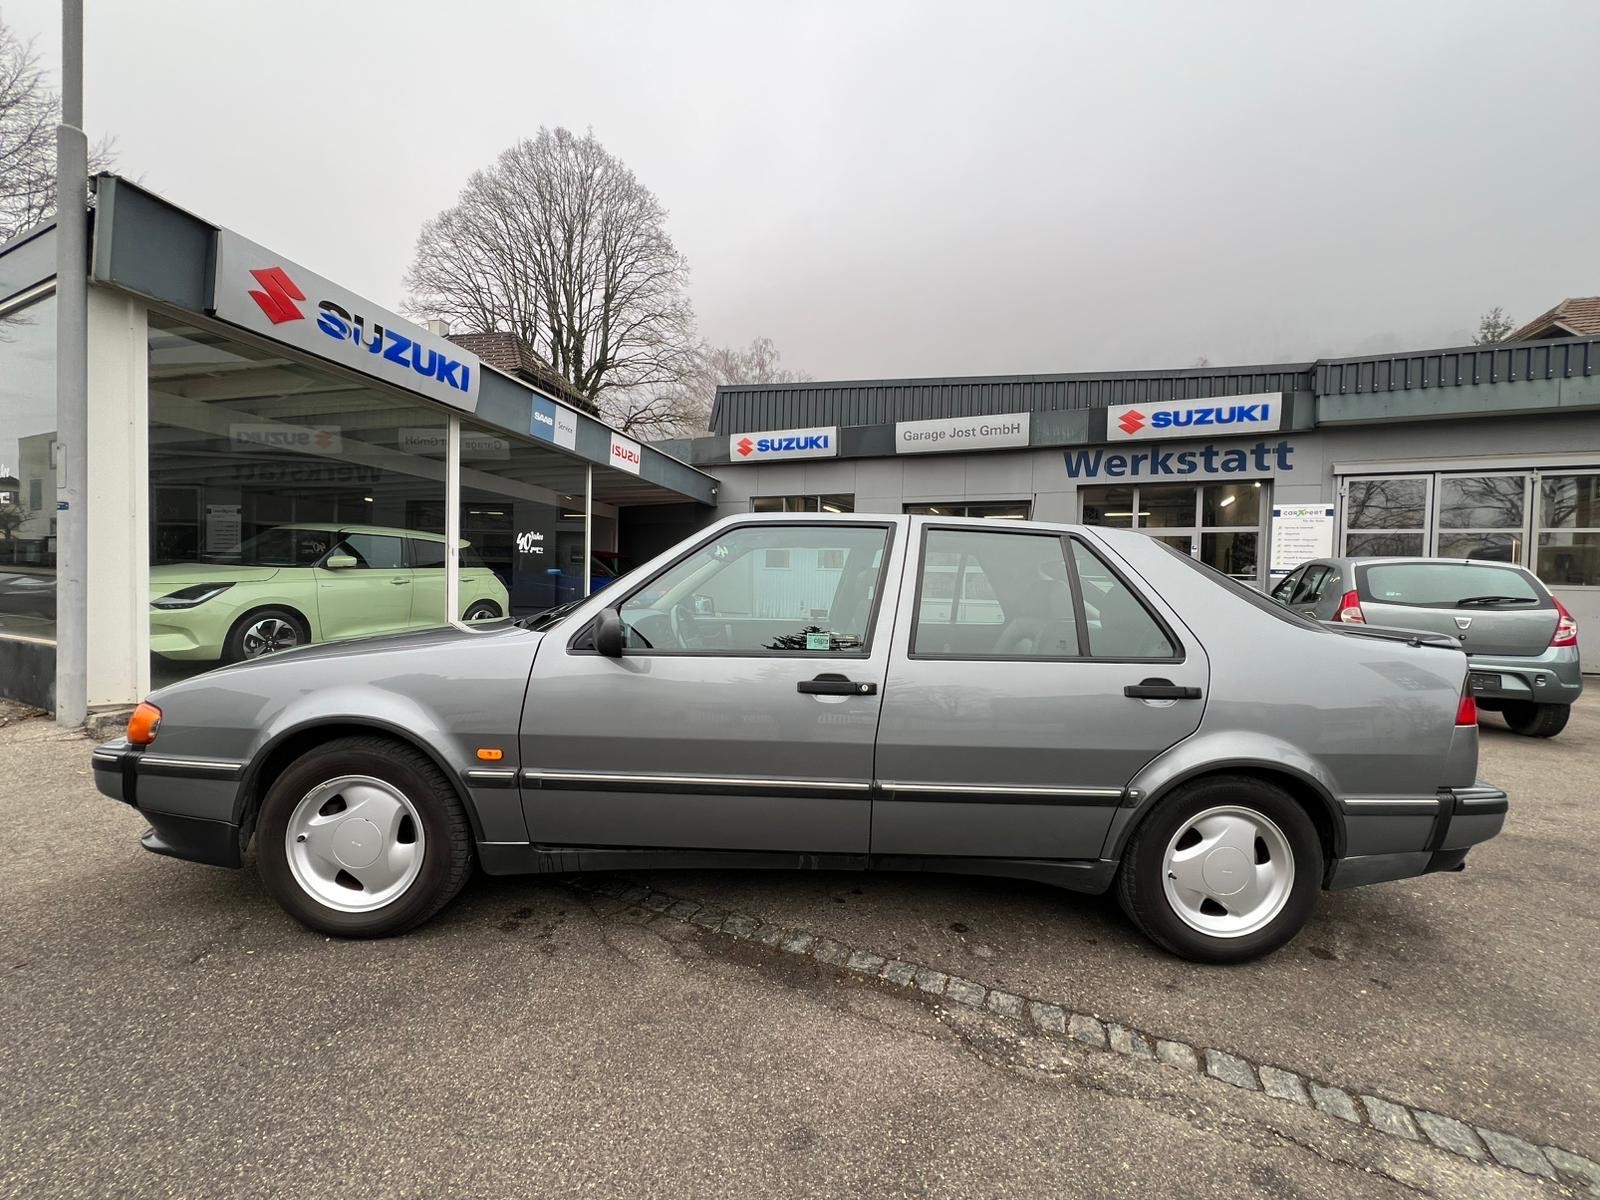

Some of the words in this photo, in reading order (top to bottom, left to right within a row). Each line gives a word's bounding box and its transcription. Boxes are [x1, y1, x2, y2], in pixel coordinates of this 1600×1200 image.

[316, 300, 470, 393] SUZUKI
[534, 411, 553, 426] SAAB
[1150, 403, 1270, 429] SUZUKI
[558, 420, 573, 434] Service
[903, 430, 946, 441] Garage
[949, 427, 977, 438] Jost
[979, 423, 1021, 437] GmbH
[756, 435, 829, 452] SUZUKI
[612, 443, 640, 465] ISUZU
[1063, 440, 1295, 478] Werkstatt
[516, 532, 532, 551] 40
